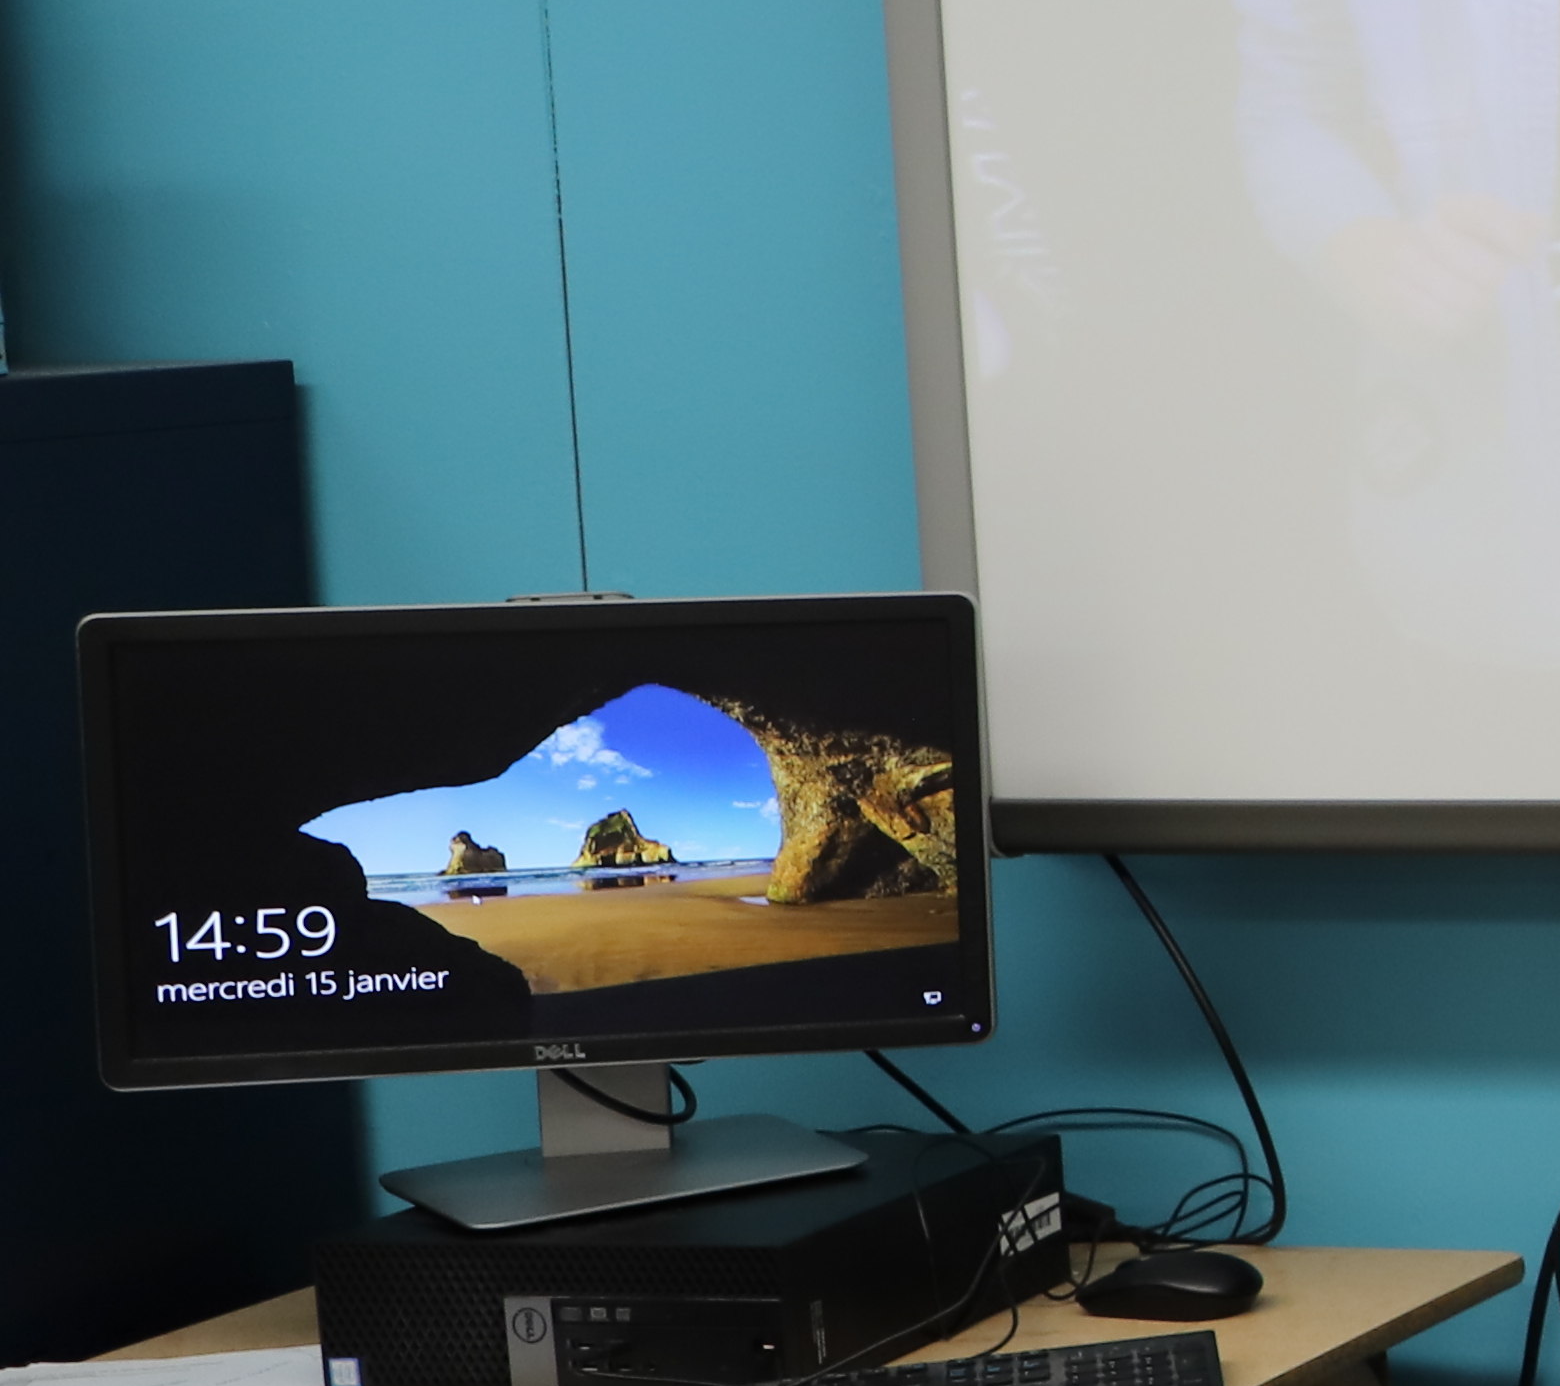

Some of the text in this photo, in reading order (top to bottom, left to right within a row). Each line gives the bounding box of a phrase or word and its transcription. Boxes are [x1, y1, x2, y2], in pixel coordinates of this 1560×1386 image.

[154, 904, 338, 964] 14:59
[157, 967, 450, 1003] mercredi 15 janvier
[535, 1042, 587, 1061] DELL
